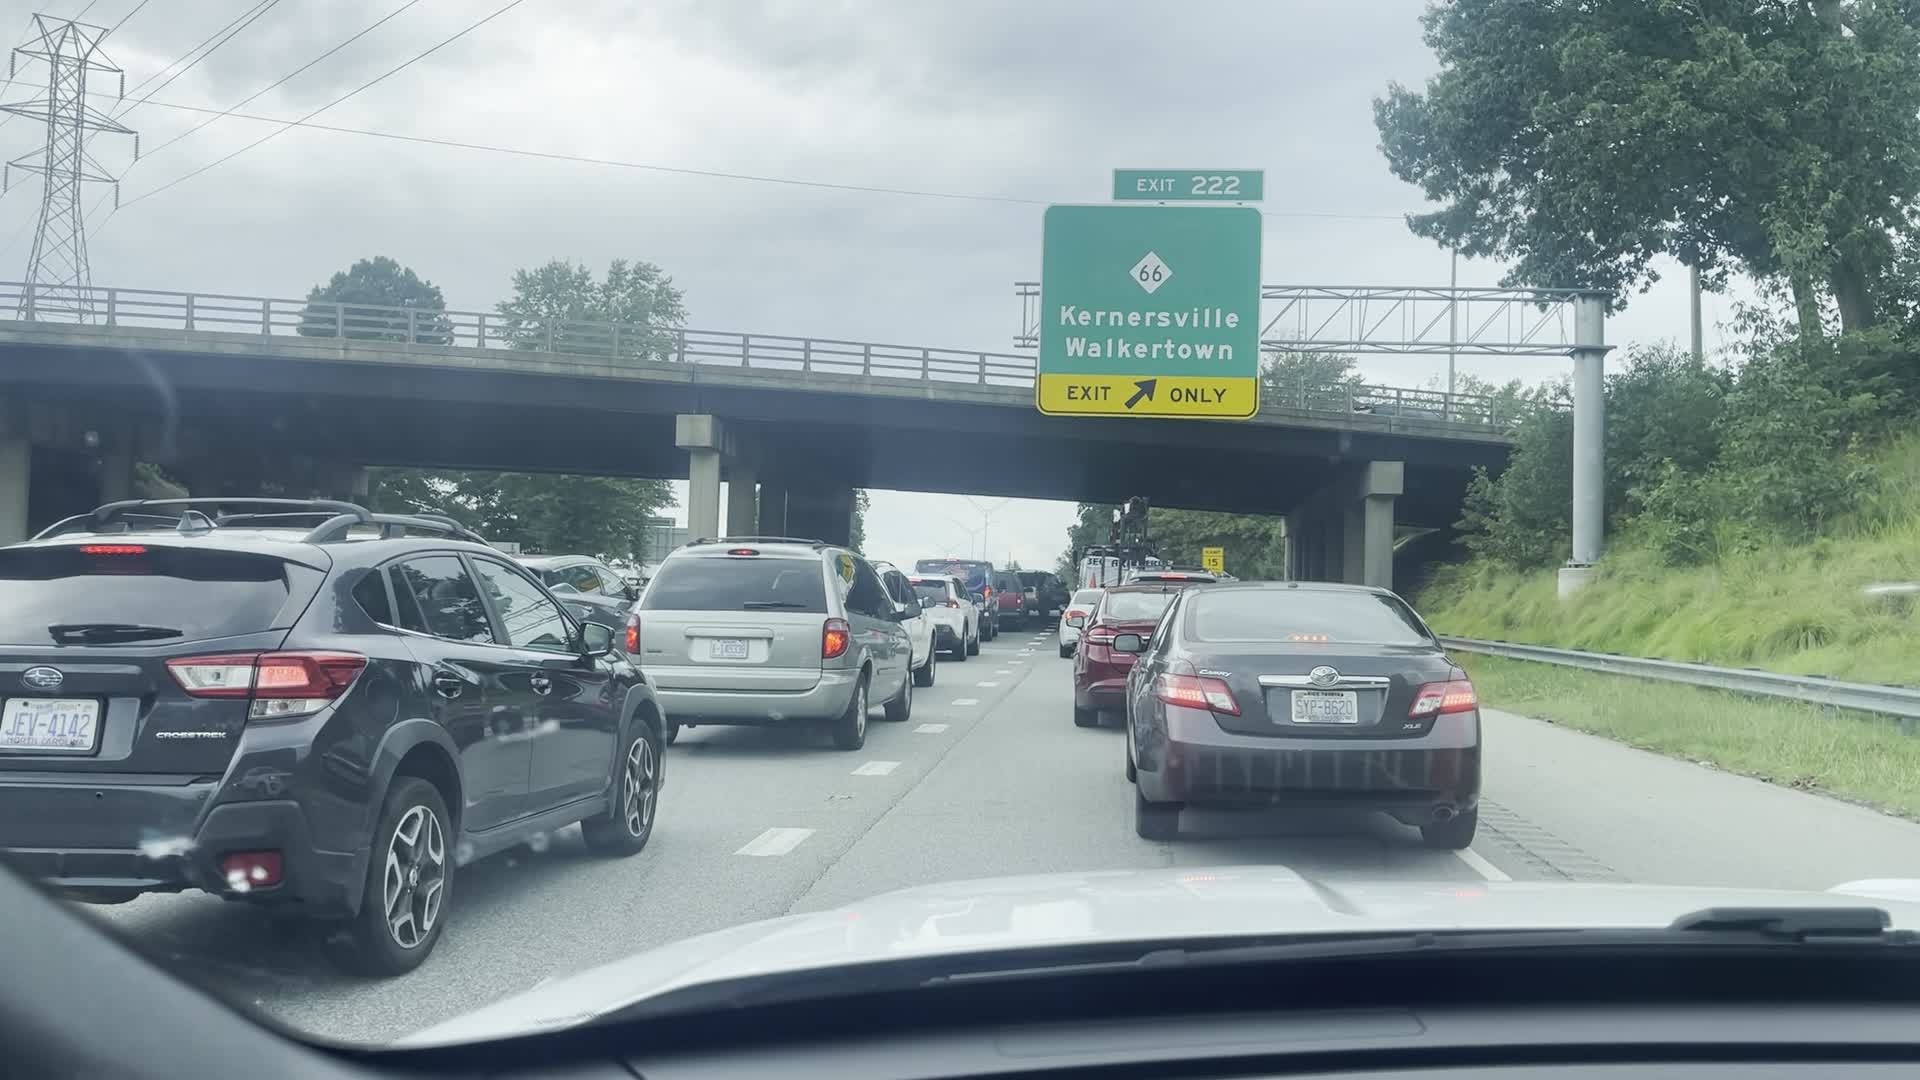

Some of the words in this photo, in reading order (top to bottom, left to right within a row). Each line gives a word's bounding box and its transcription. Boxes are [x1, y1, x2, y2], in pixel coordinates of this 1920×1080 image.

[1136, 178, 1176, 192] EXIT
[1191, 175, 1241, 195] 222
[1139, 265, 1163, 282] 66
[1060, 305, 1240, 328] Kernersville
[1066, 337, 1233, 360] Walkertown
[1067, 385, 1112, 400] EXIT
[1170, 388, 1227, 403] ONLY
[1207, 558, 1218, 567] 15
[1295, 699, 1353, 715] SYP-8620
[5, 711, 91, 738] JEV-4142
